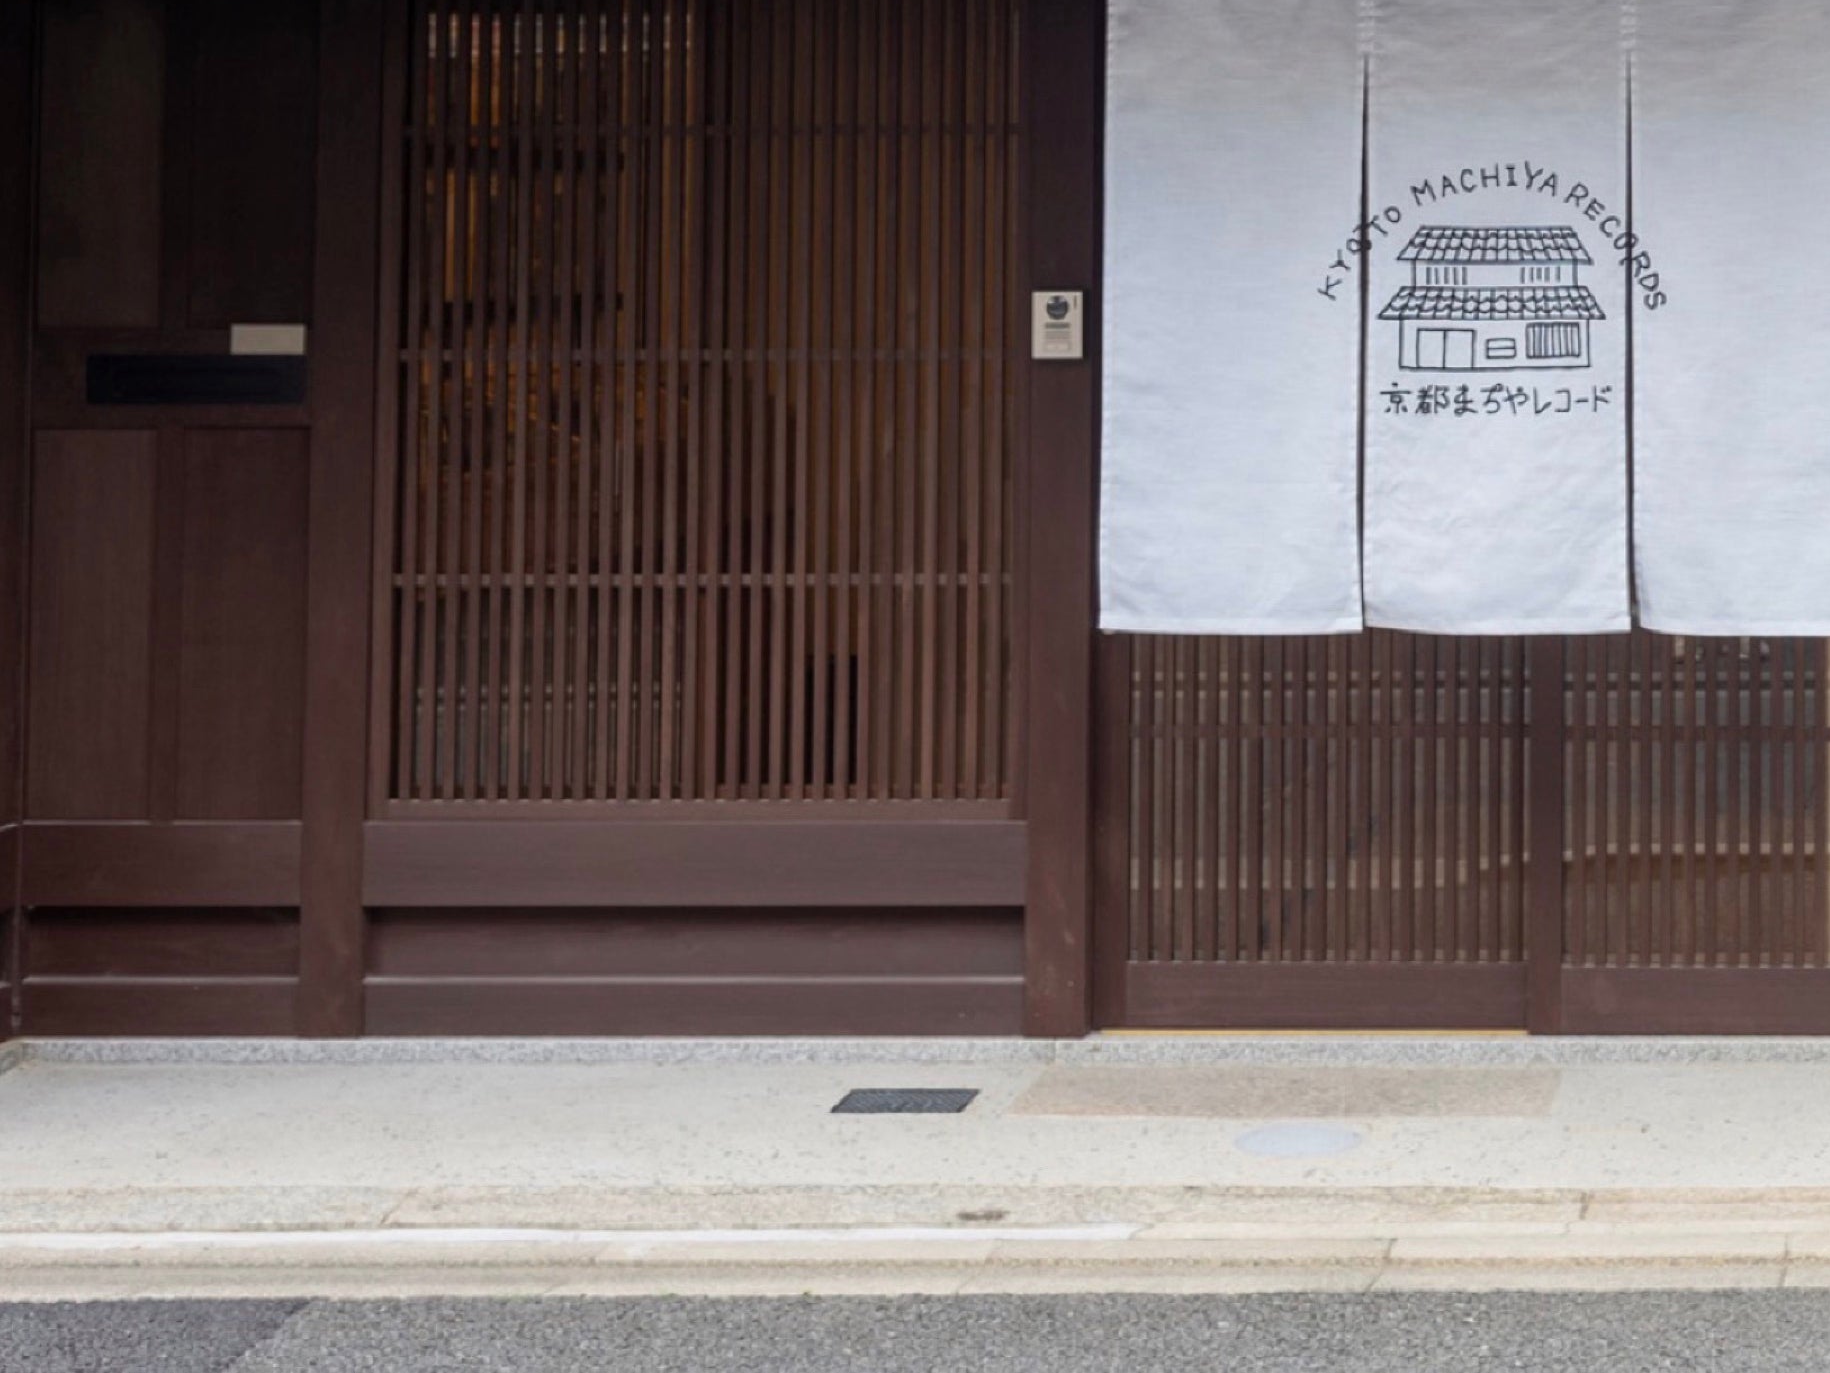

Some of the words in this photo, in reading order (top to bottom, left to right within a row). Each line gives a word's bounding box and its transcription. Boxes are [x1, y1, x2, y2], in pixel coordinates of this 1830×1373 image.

[1318, 205, 1402, 301] KYOTO
[1410, 164, 1558, 206] MACHIYA
[1563, 182, 1667, 310] RECORDS
